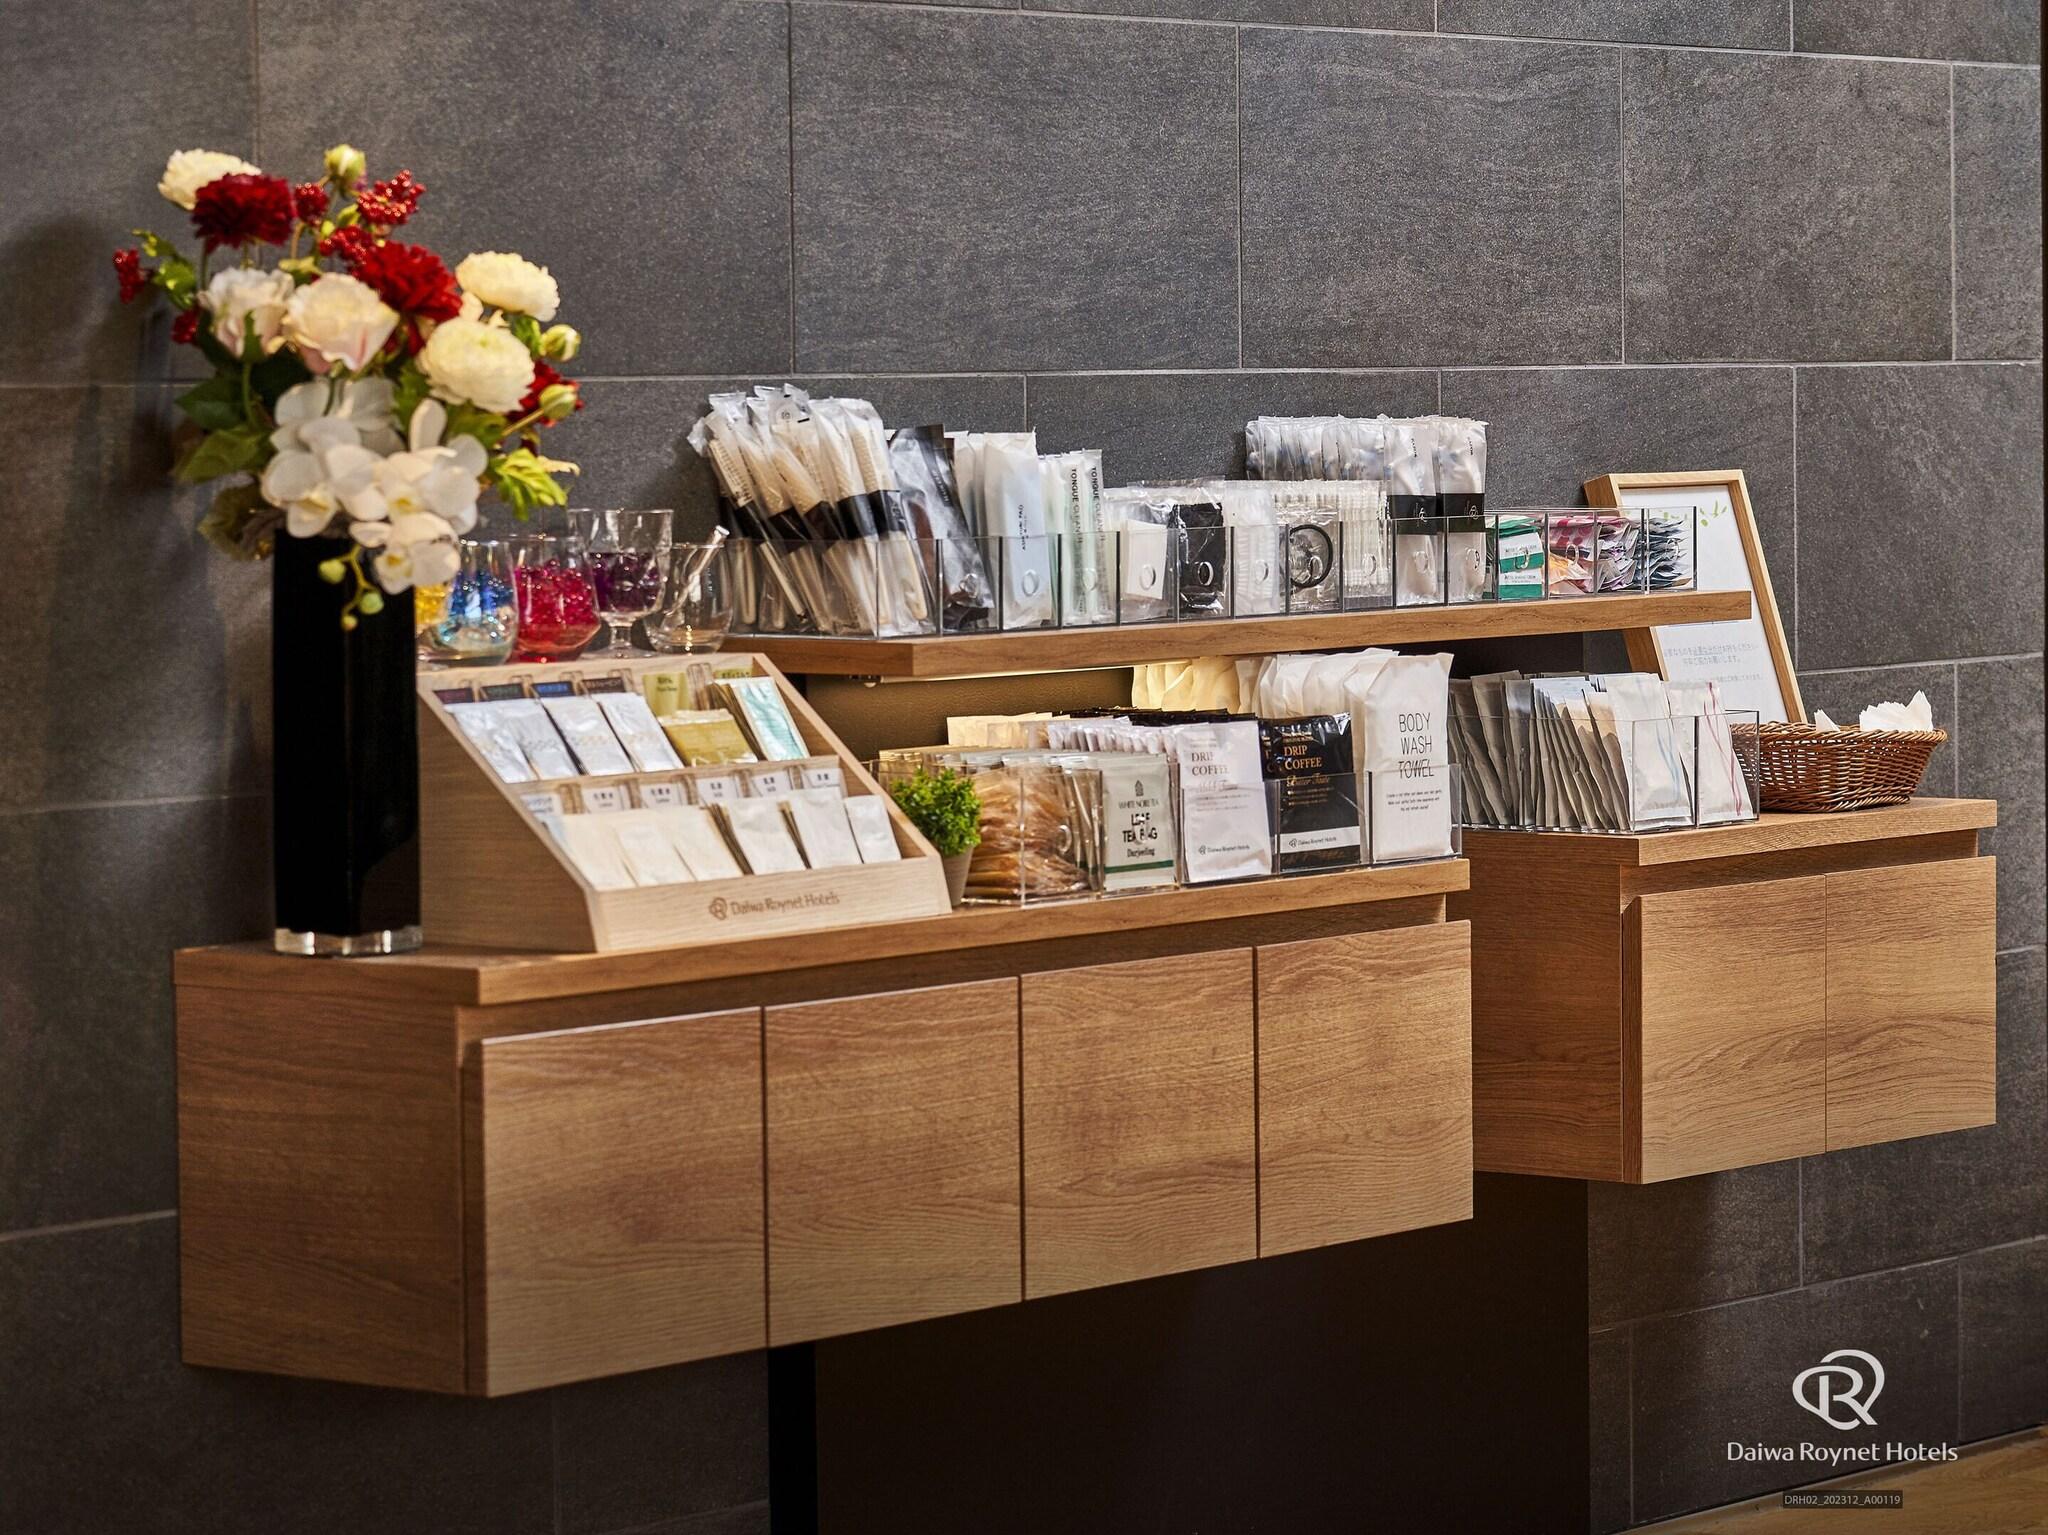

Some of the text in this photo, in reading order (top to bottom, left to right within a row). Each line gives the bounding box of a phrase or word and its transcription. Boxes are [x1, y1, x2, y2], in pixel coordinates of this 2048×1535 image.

[1070, 468, 1079, 502] TONGUE
[1091, 466, 1100, 500] TONGUE
[1398, 712, 1431, 733] BODY
[1283, 745, 1308, 757] DRIP
[1400, 735, 1433, 755] WASH
[1284, 757, 1322, 770] COFFEE
[1398, 758, 1435, 779] TOWEL
[730, 891, 841, 915] Daiwa Roynet Hotels
